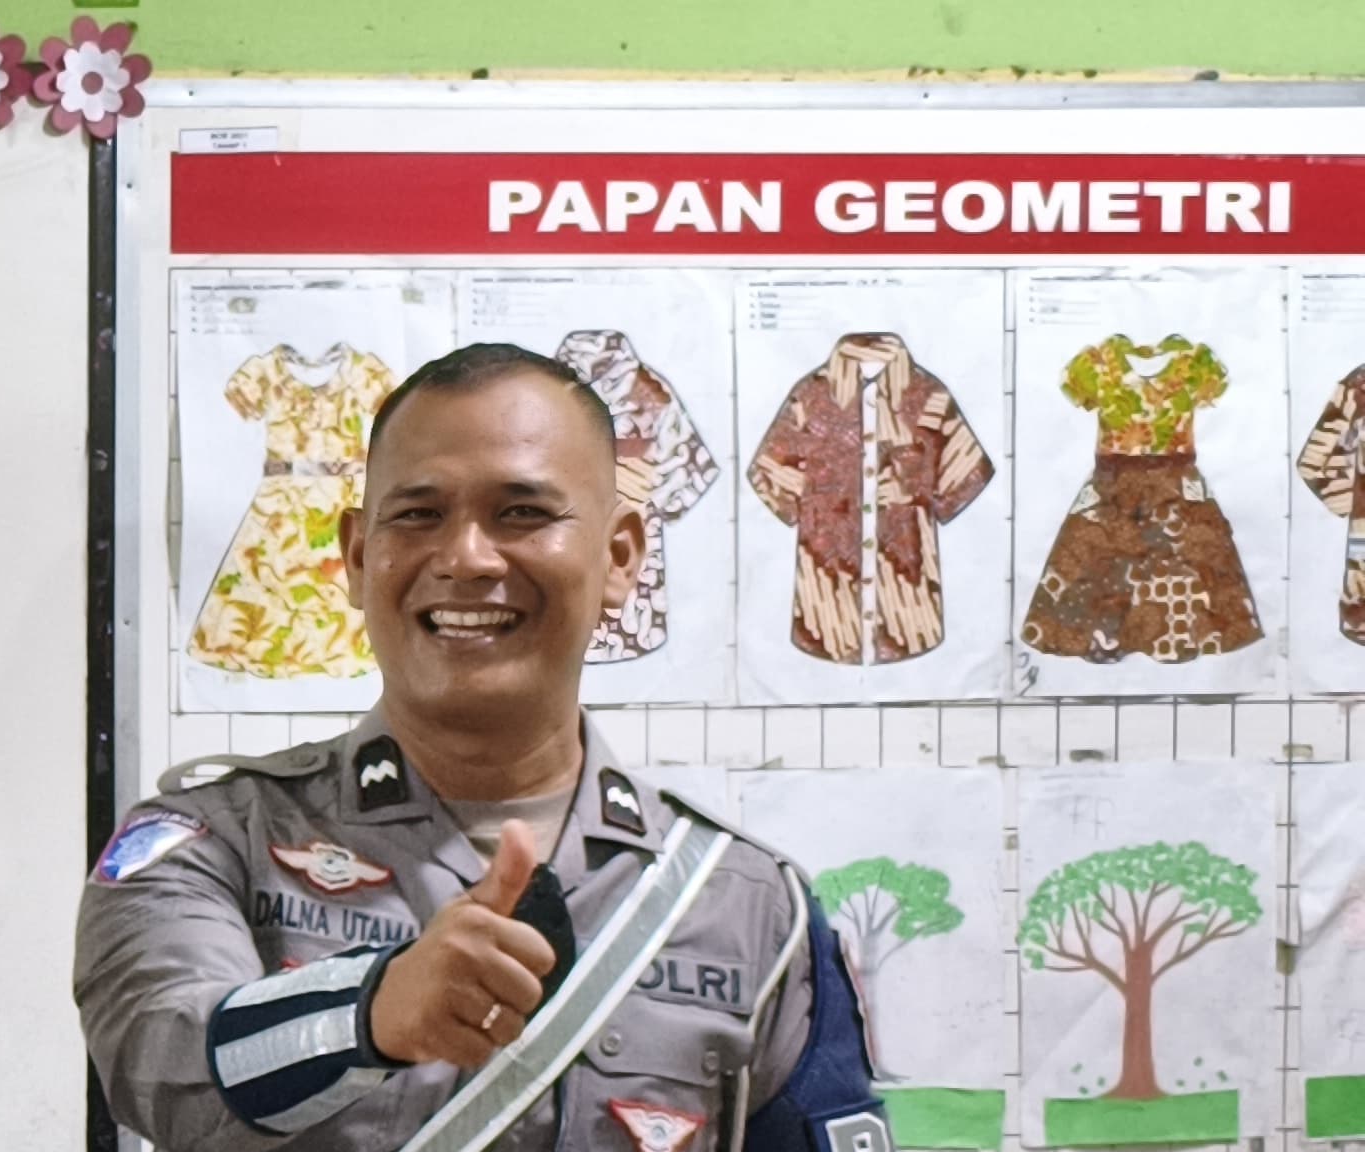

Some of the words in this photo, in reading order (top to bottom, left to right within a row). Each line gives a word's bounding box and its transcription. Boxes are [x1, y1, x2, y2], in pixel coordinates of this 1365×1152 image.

[488, 180, 782, 233] PAPAN
[813, 180, 1292, 234] GEOMETRI
[254, 889, 330, 936] DALNA
[635, 958, 742, 1005] OLRI
